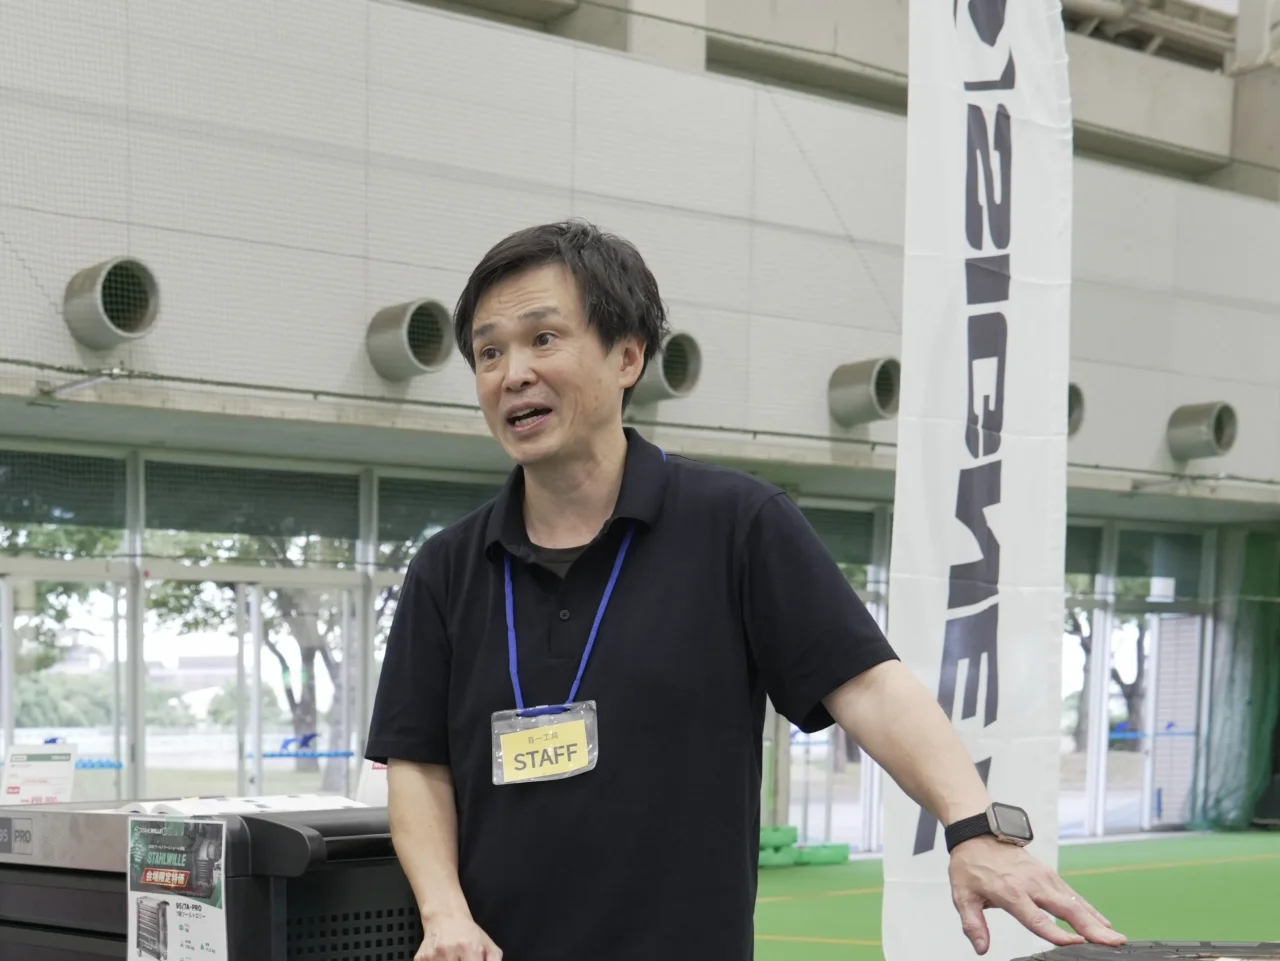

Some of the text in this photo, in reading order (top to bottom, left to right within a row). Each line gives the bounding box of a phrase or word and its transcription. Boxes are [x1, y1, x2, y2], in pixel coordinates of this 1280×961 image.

[513, 743, 578, 771] STAFF
[14, 829, 31, 844] PRO
[148, 851, 187, 866] STAHLWILLE
